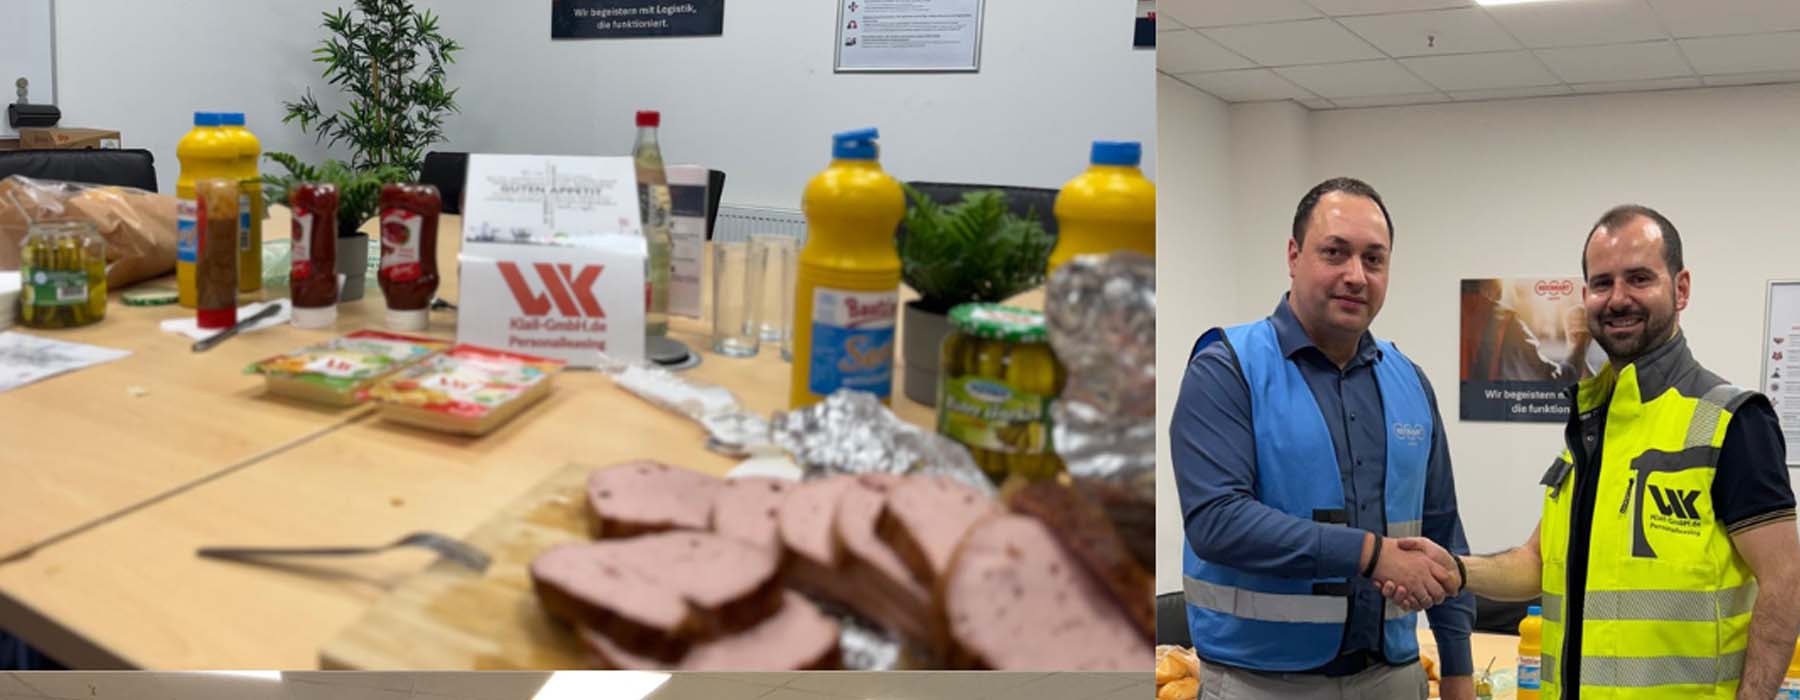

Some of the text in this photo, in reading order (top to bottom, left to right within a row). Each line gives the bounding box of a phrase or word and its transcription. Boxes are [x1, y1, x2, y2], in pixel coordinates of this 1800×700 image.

[574, 4, 696, 18] Wir begeistern mit Logistik,
[597, 19, 669, 29] die funktioniert.
[501, 184, 602, 196] GUTEN APPETIT
[509, 335, 606, 352] Personalleasing
[1485, 389, 1501, 399] Wir
[1503, 389, 1556, 402] begeistern
[1511, 403, 1571, 413] die funktion
[1650, 522, 1701, 537] Personalleasing
